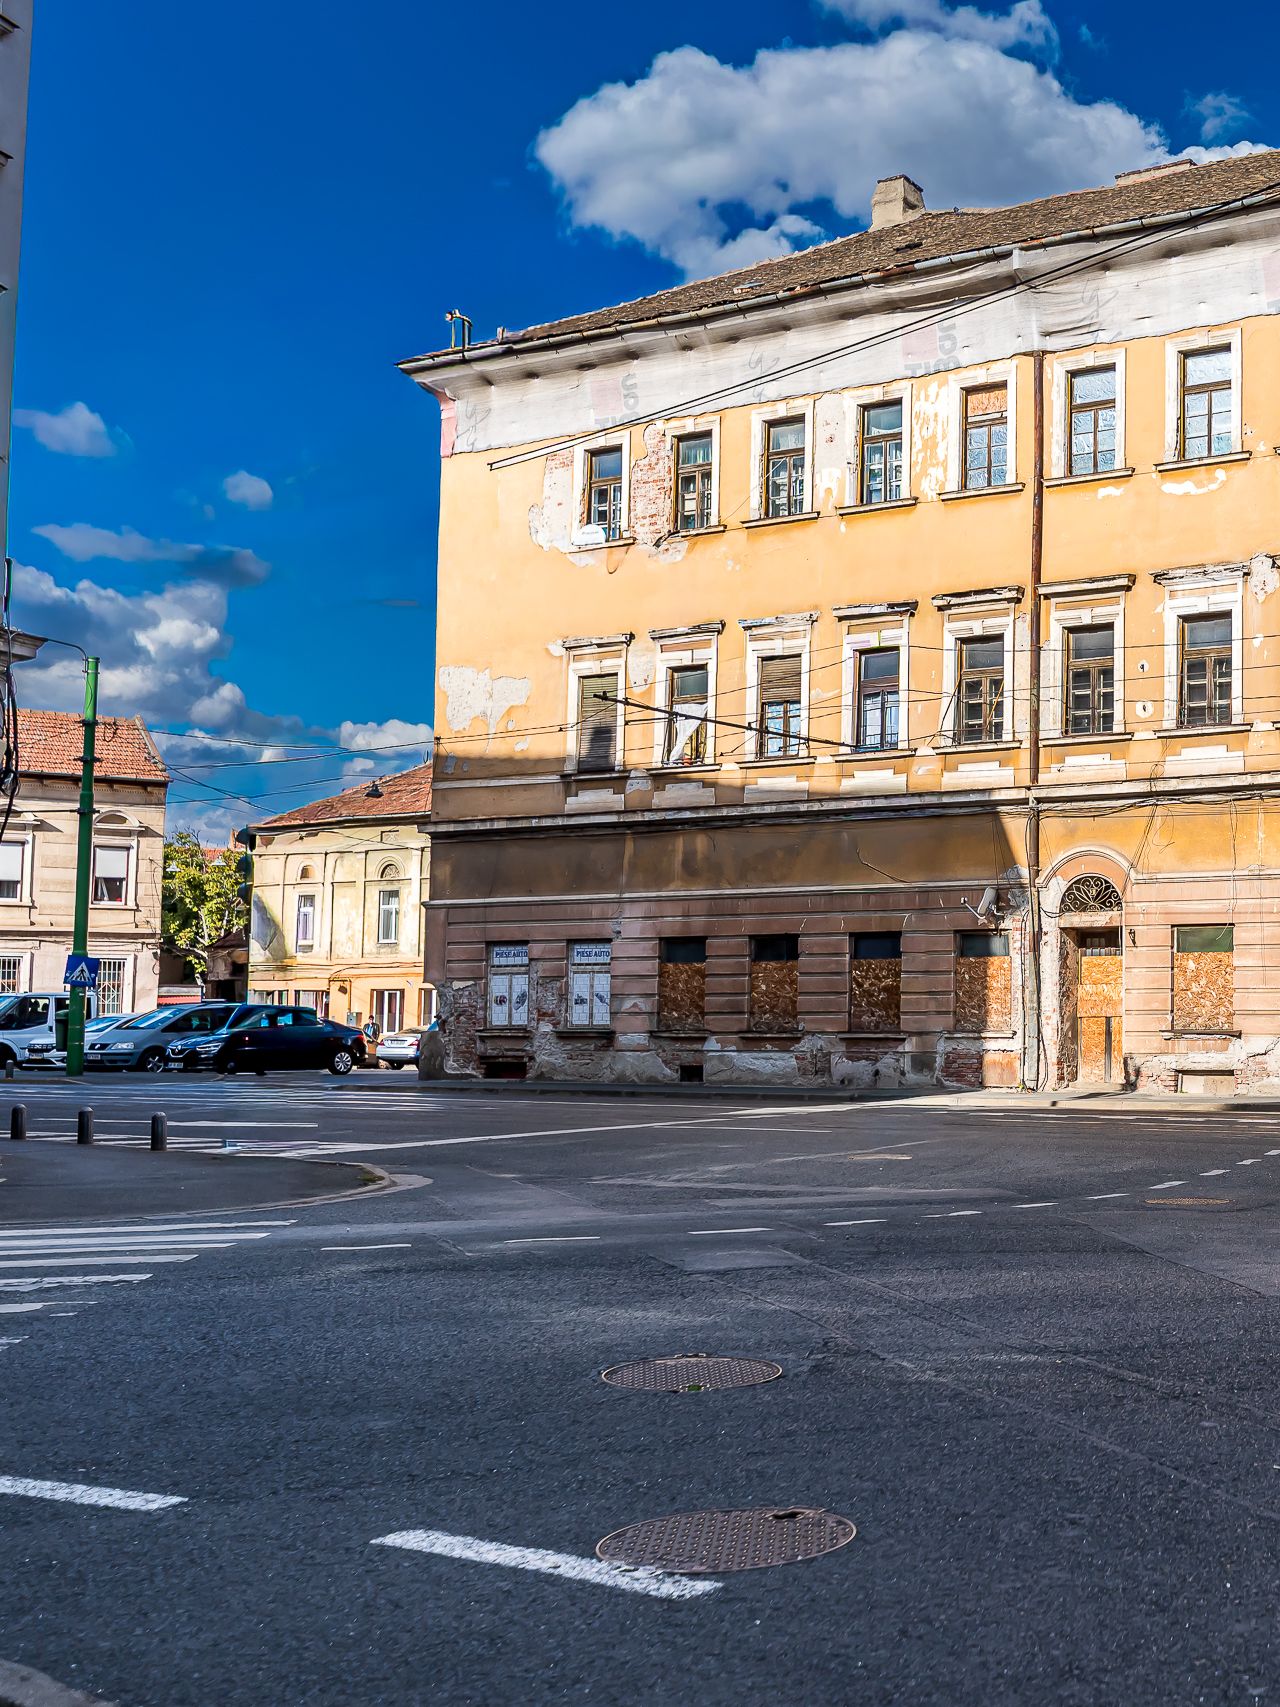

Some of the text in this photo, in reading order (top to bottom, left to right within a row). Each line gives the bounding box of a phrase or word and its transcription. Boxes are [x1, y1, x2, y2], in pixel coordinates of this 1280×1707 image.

[495, 950, 528, 958] PIESE AUTO
[576, 949, 611, 958] PIESE AUTO
